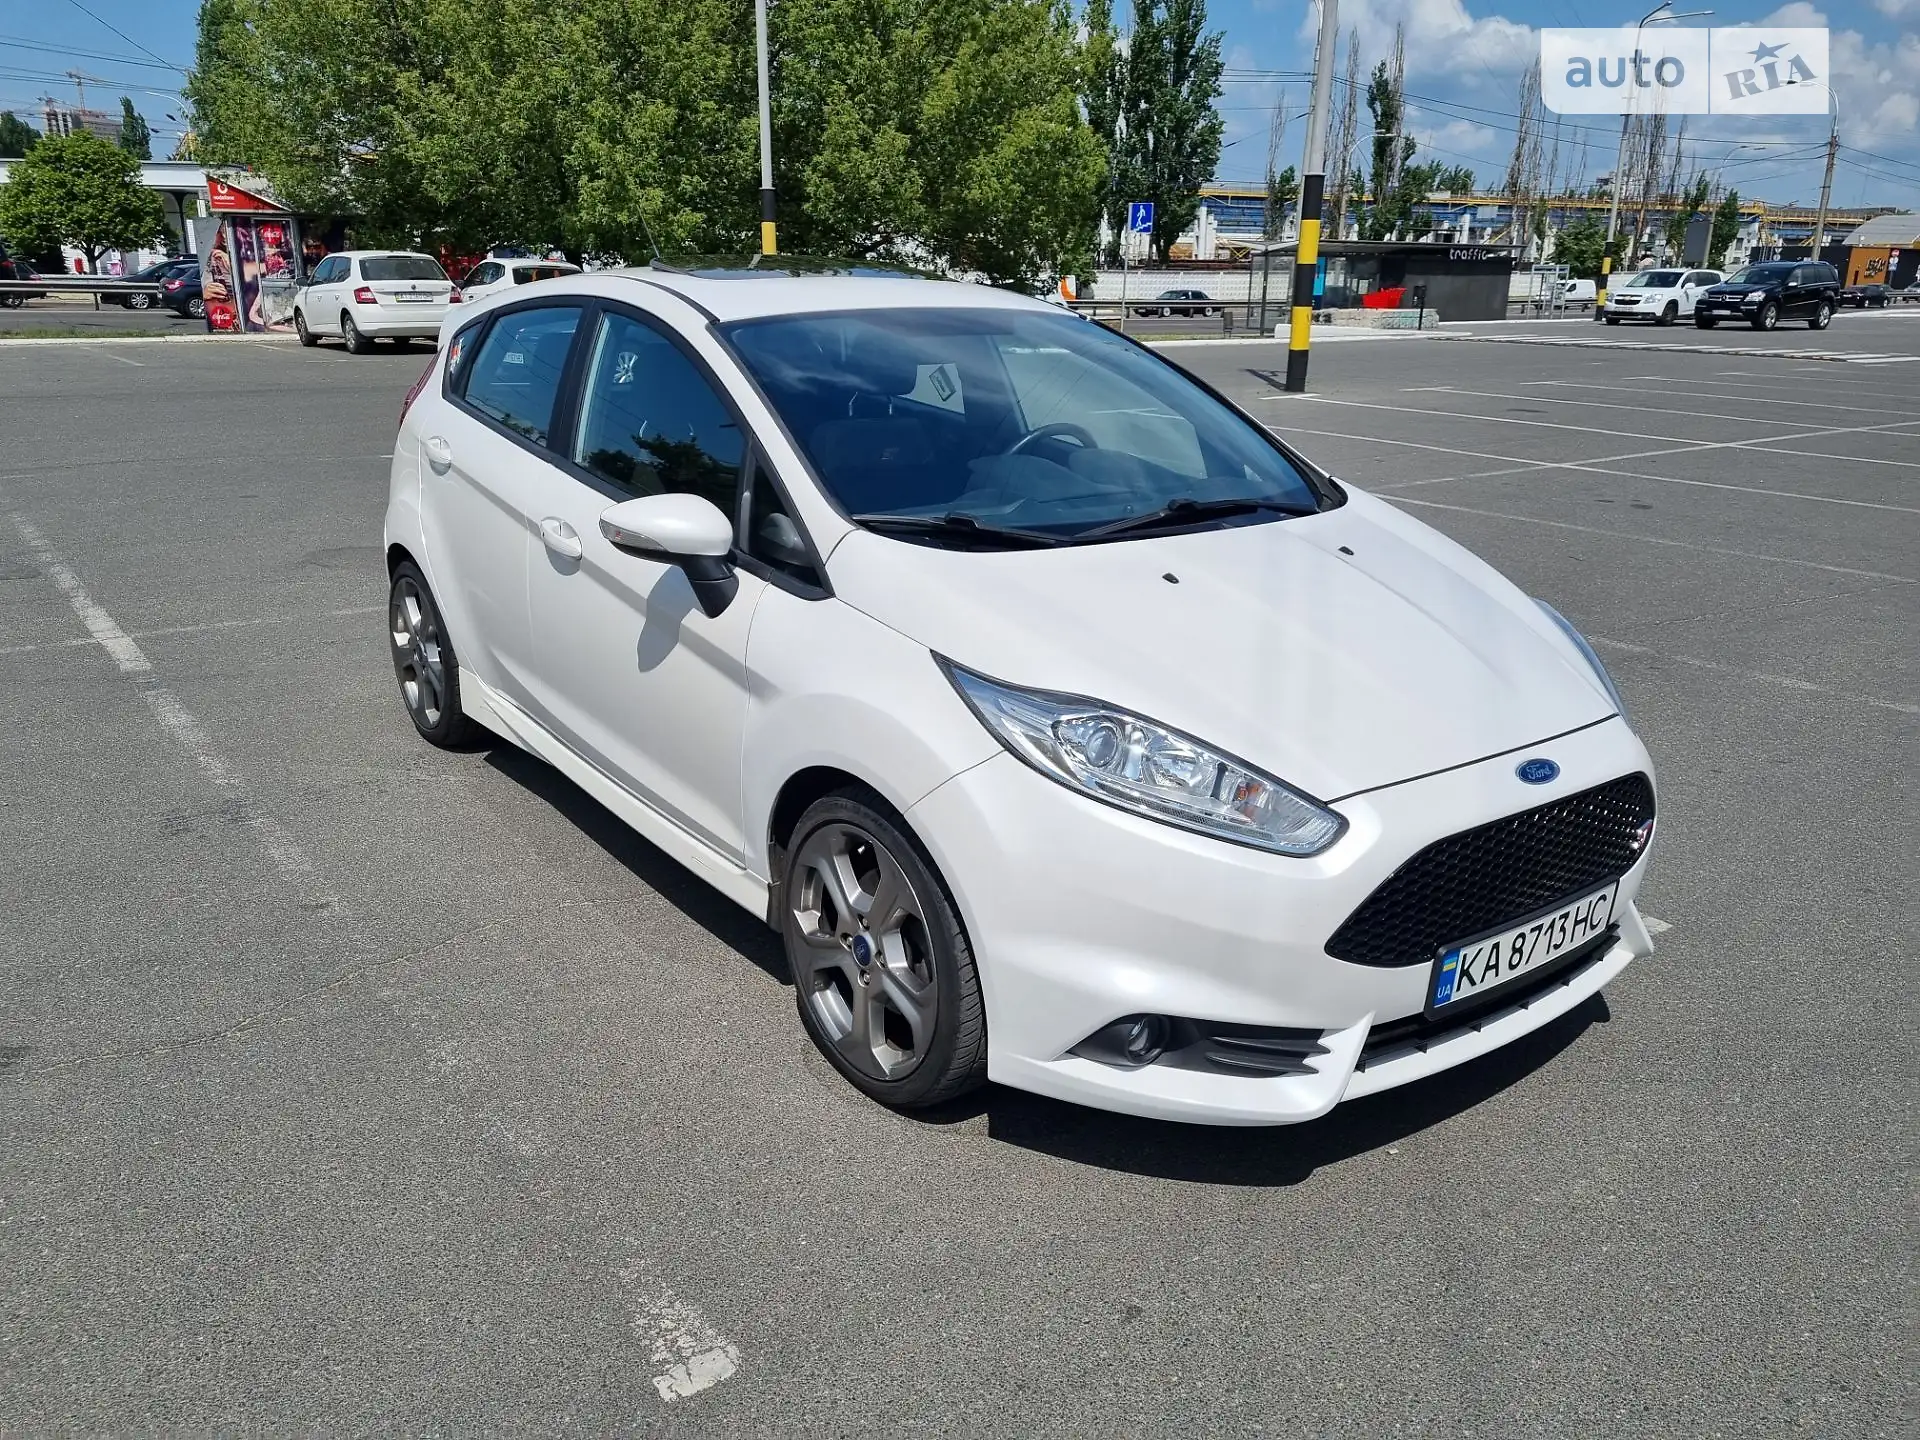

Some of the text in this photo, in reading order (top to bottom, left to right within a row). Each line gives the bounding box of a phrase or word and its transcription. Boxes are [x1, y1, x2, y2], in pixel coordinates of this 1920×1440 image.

[1449, 248, 1488, 260] traffic
[1526, 764, 1552, 780] Ford
[1456, 893, 1608, 993] KA 8713 HC
[1438, 985, 1451, 998] UA
